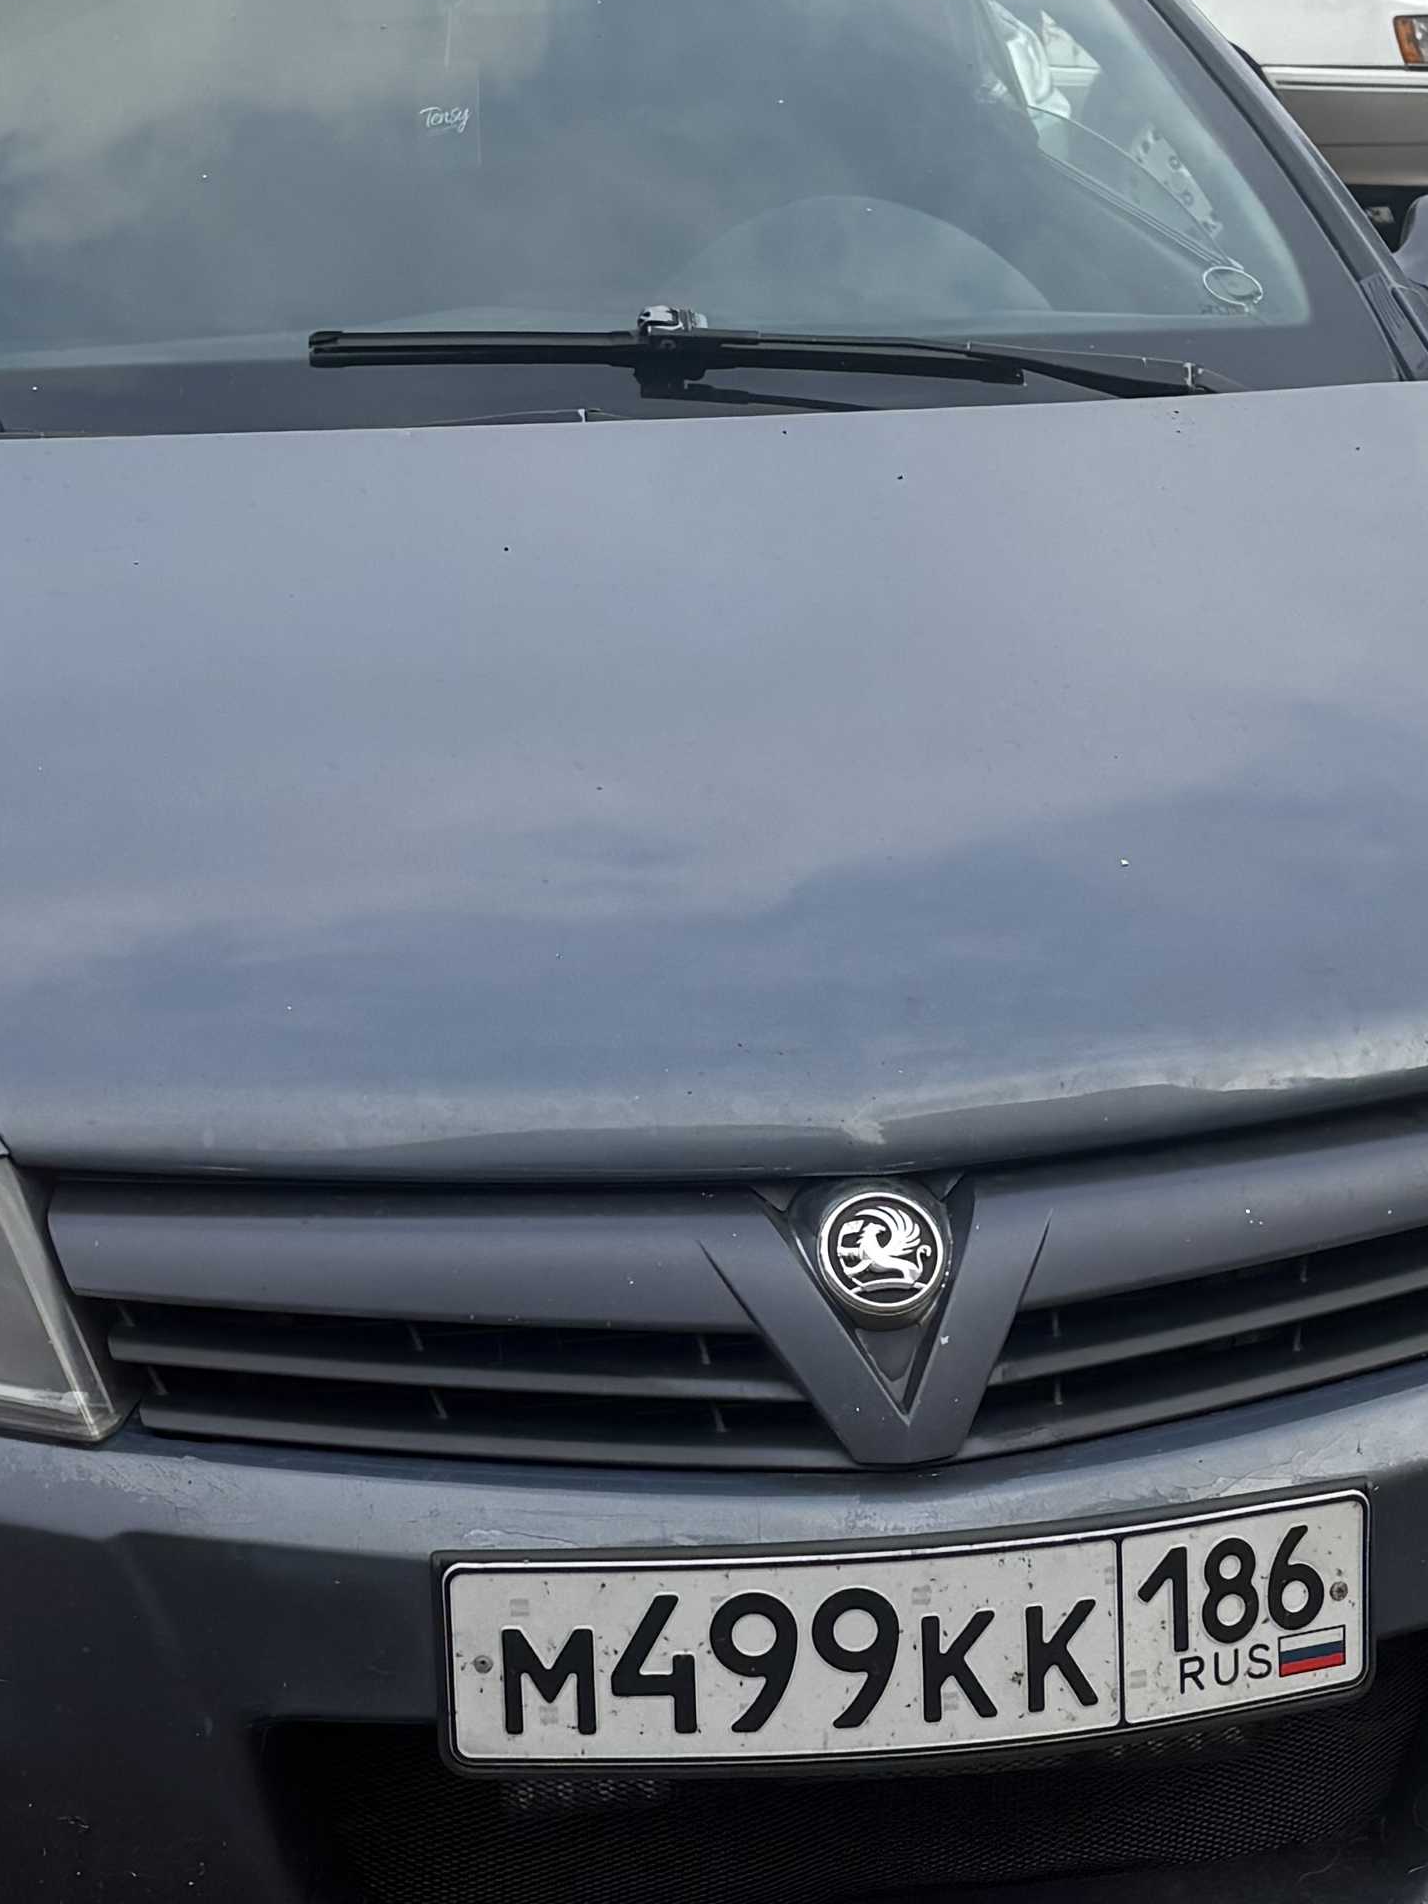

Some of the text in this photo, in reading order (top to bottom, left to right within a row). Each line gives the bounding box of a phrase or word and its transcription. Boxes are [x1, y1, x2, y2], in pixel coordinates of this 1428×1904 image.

[501, 1524, 1325, 1736] М499КК 186
[1178, 1642, 1273, 1695] RUS
